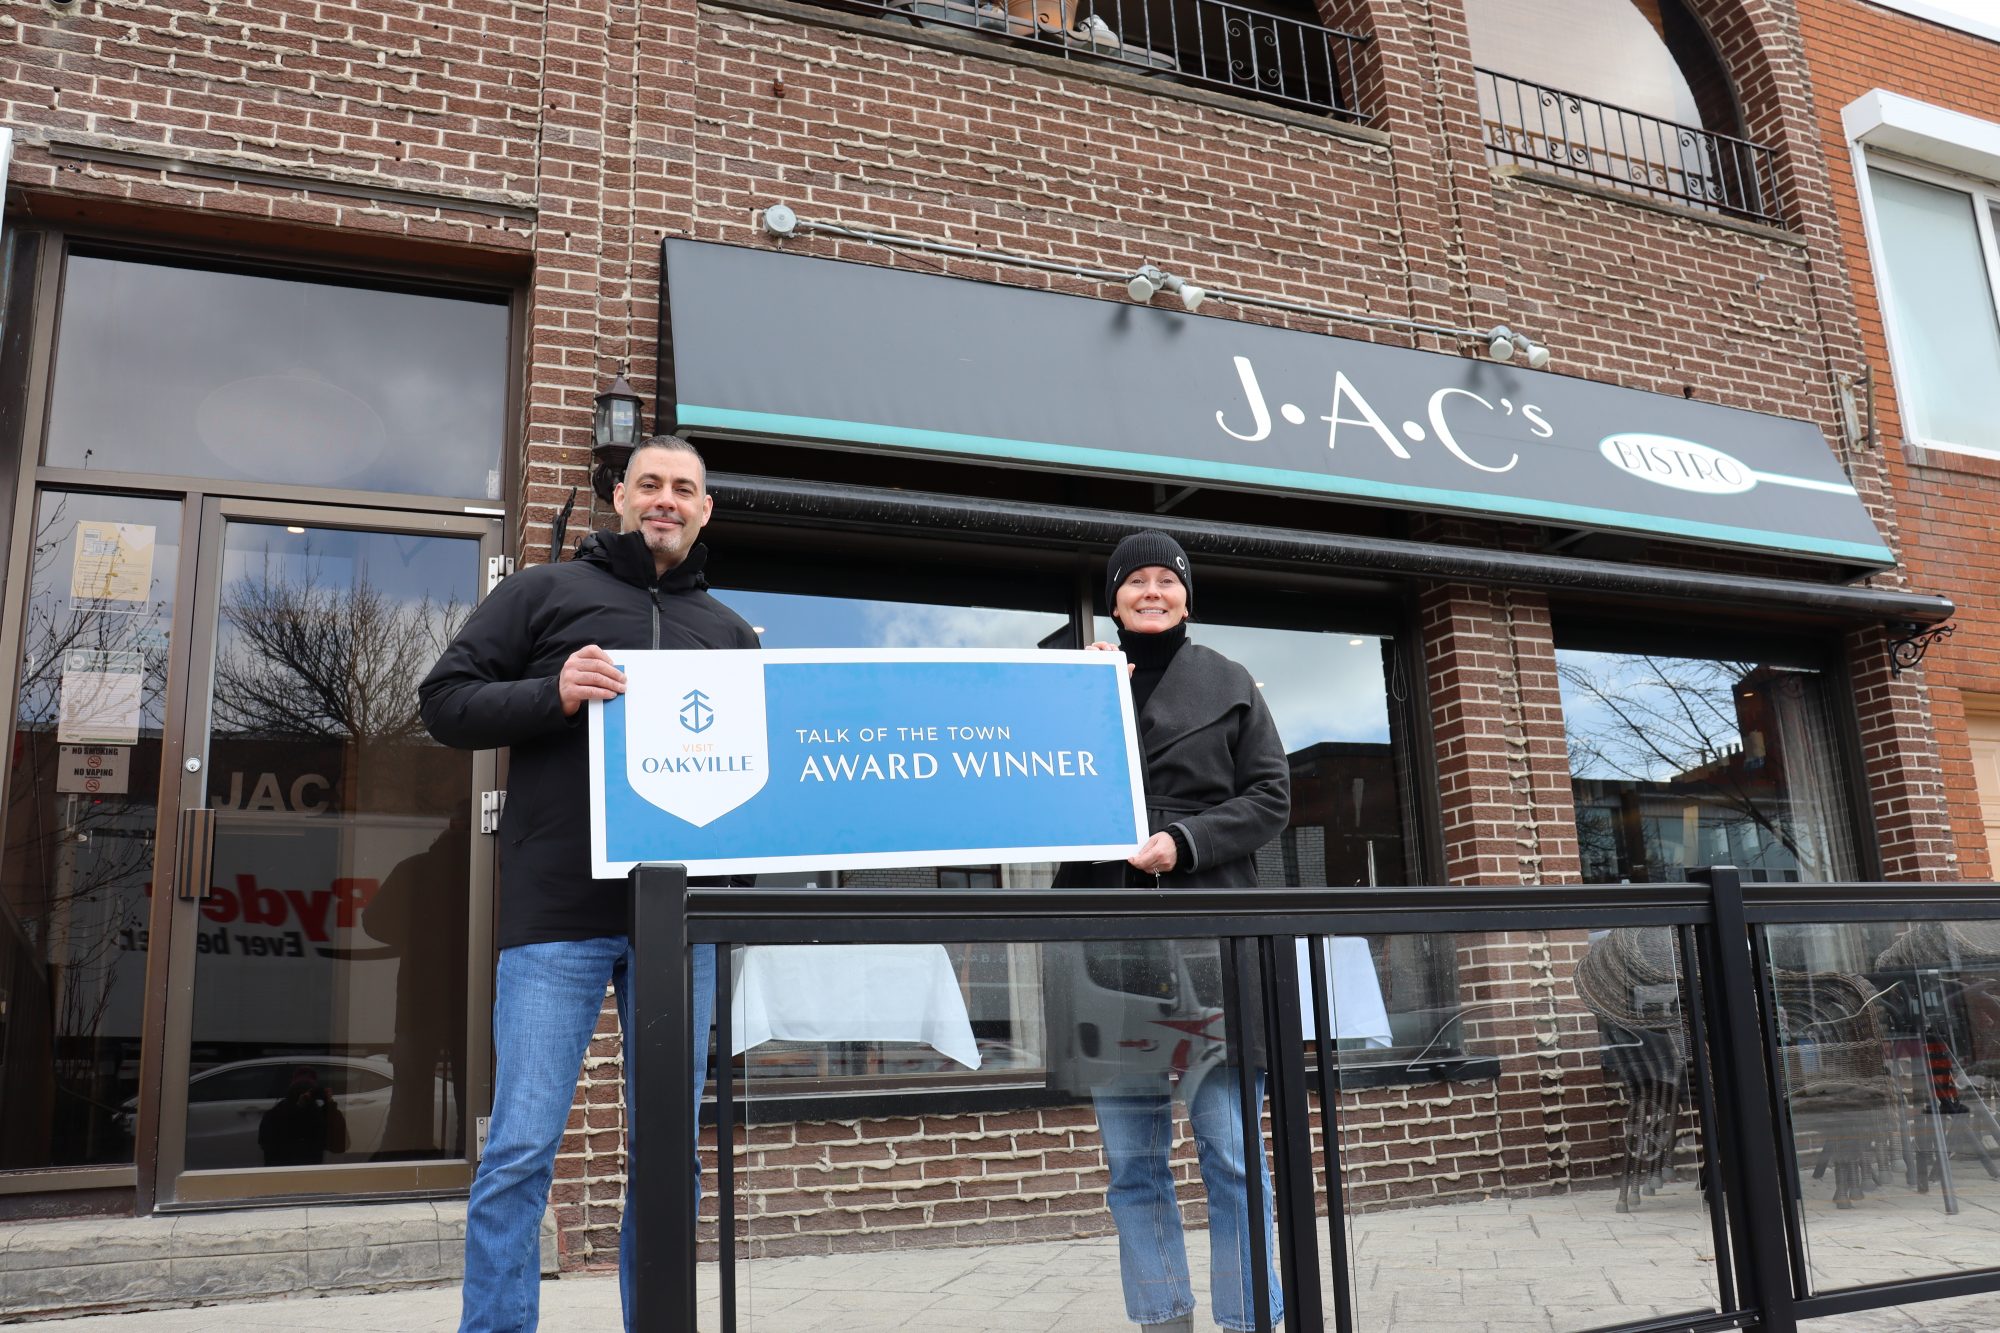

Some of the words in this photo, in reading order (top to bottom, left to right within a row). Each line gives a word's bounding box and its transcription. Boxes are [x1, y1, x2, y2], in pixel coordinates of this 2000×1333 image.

[1613, 440, 1742, 485] BISTRO
[796, 729, 849, 743] TALK
[859, 728, 888, 742] OF
[897, 727, 938, 742] THE
[947, 726, 1011, 741] TOWN
[72, 747, 82, 755] NO
[84, 747, 118, 755] SMOKING
[683, 743, 714, 753] VISIT
[74, 768, 84, 776] NO
[86, 768, 113, 776] VAPING
[642, 755, 753, 774] OAKVILLE
[799, 753, 938, 782] AWARD
[952, 750, 1099, 777] WINNER
